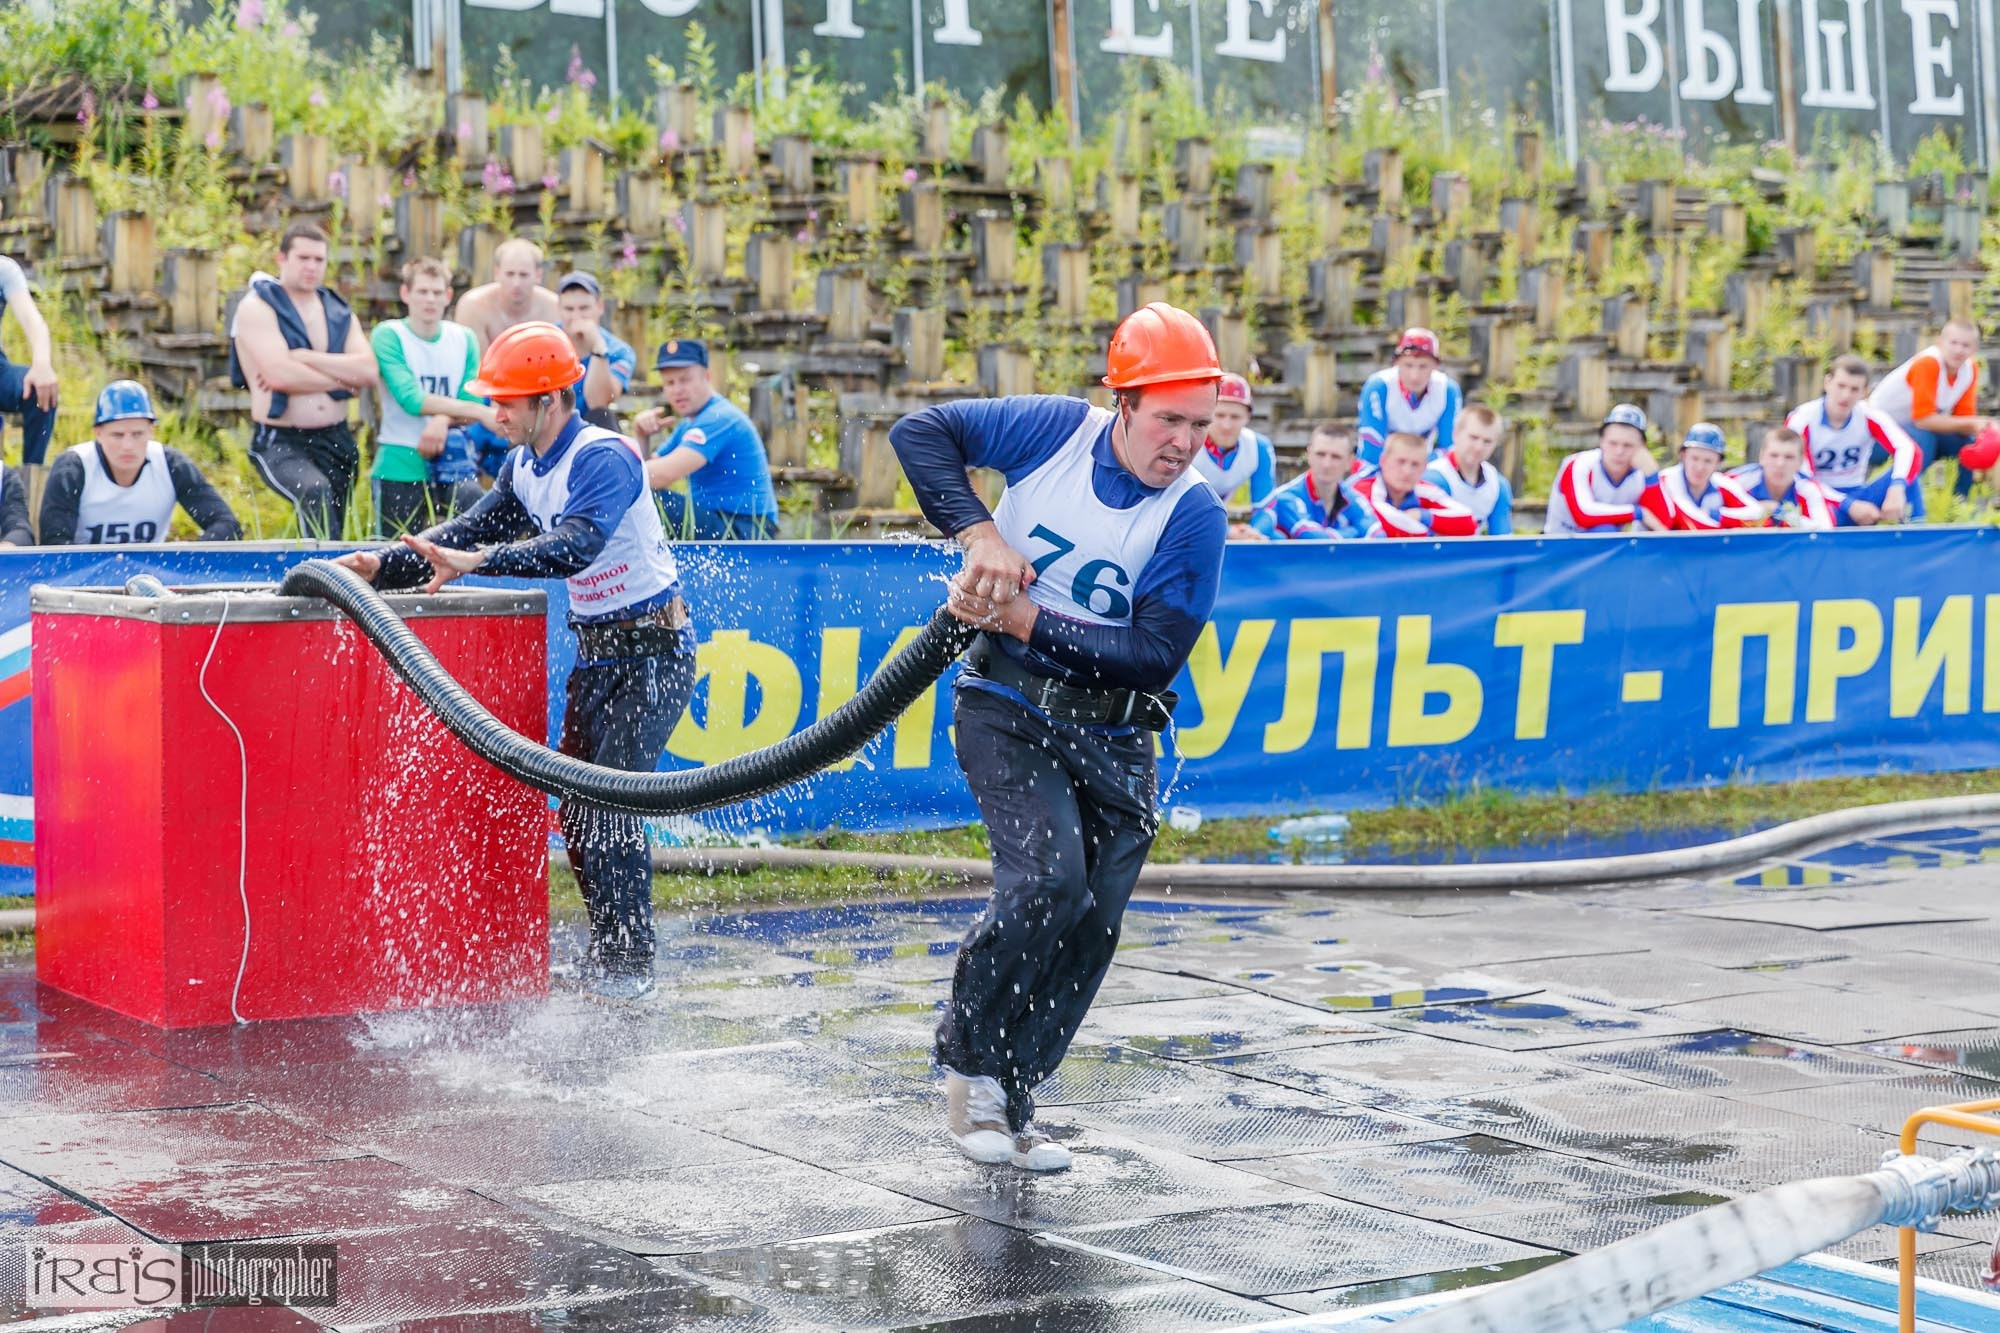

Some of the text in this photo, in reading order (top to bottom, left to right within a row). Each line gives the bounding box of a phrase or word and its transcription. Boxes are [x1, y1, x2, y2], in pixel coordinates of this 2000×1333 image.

[1604, 0, 1965, 116] ВЫШЕ
[1814, 446, 1861, 470] 28
[1027, 523, 1131, 619] 76
[665, 609, 1587, 769] ФИУЛЬТ
